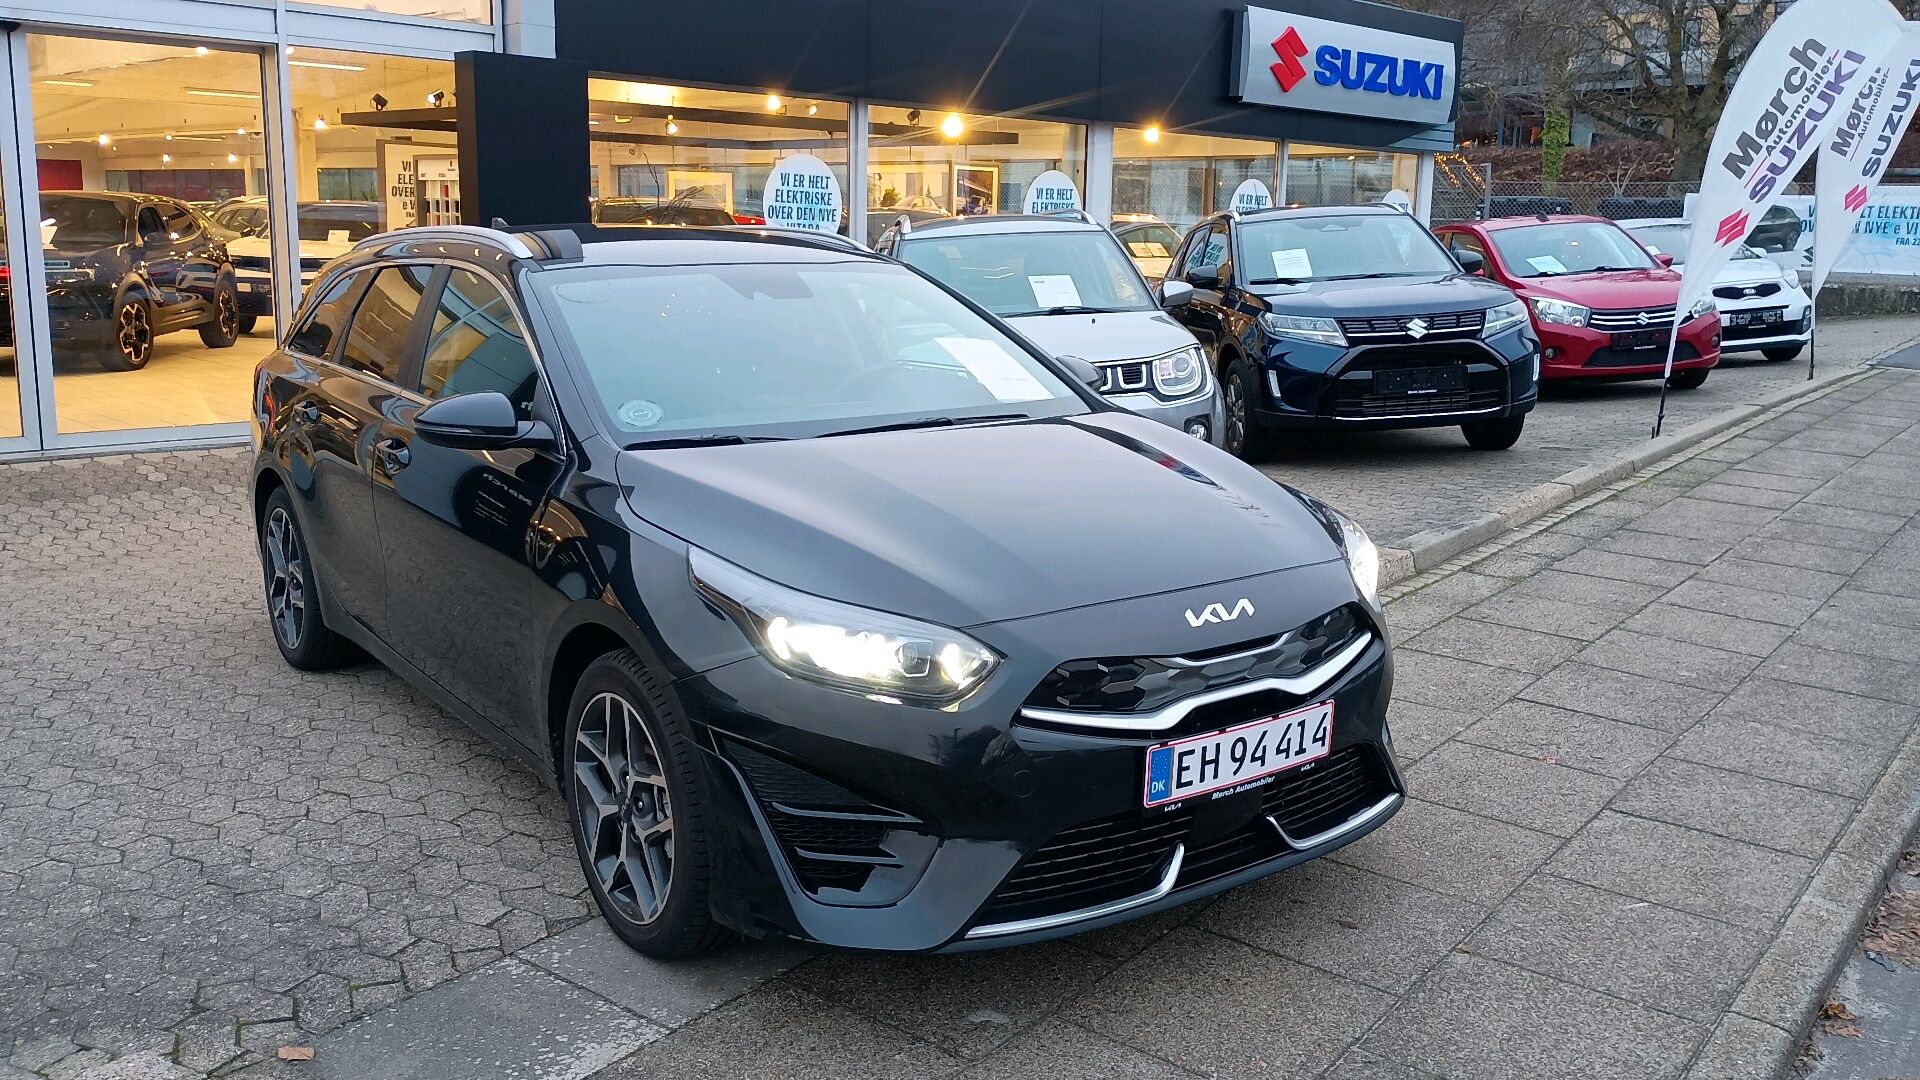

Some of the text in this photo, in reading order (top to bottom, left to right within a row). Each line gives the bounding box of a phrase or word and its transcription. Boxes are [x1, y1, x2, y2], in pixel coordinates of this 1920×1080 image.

[1314, 45, 1444, 100] SUZUKI
[1722, 38, 1827, 180] Mørch
[1765, 56, 1834, 157] Automobiler
[1858, 72, 1889, 140] Automobiler
[1749, 49, 1866, 203] SUZUKI
[1862, 58, 1920, 178] SUZUKI
[402, 161, 411, 172] VI
[780, 172, 830, 189] VI ER HELT
[775, 188, 833, 206] ELEKTRISKE
[1036, 187, 1073, 201] VI ER HELT
[1246, 194, 1253, 205] ER
[768, 205, 837, 222] OVER DEN NYE
[1864, 221, 1890, 235] NYE
[1894, 224, 1901, 235] e
[1896, 237, 1910, 246] FRA
[1184, 598, 1255, 628] KIA
[1175, 711, 1329, 790] EH 94 414
[1151, 779, 1166, 794] DK
[1234, 775, 1276, 794] Automobiler
